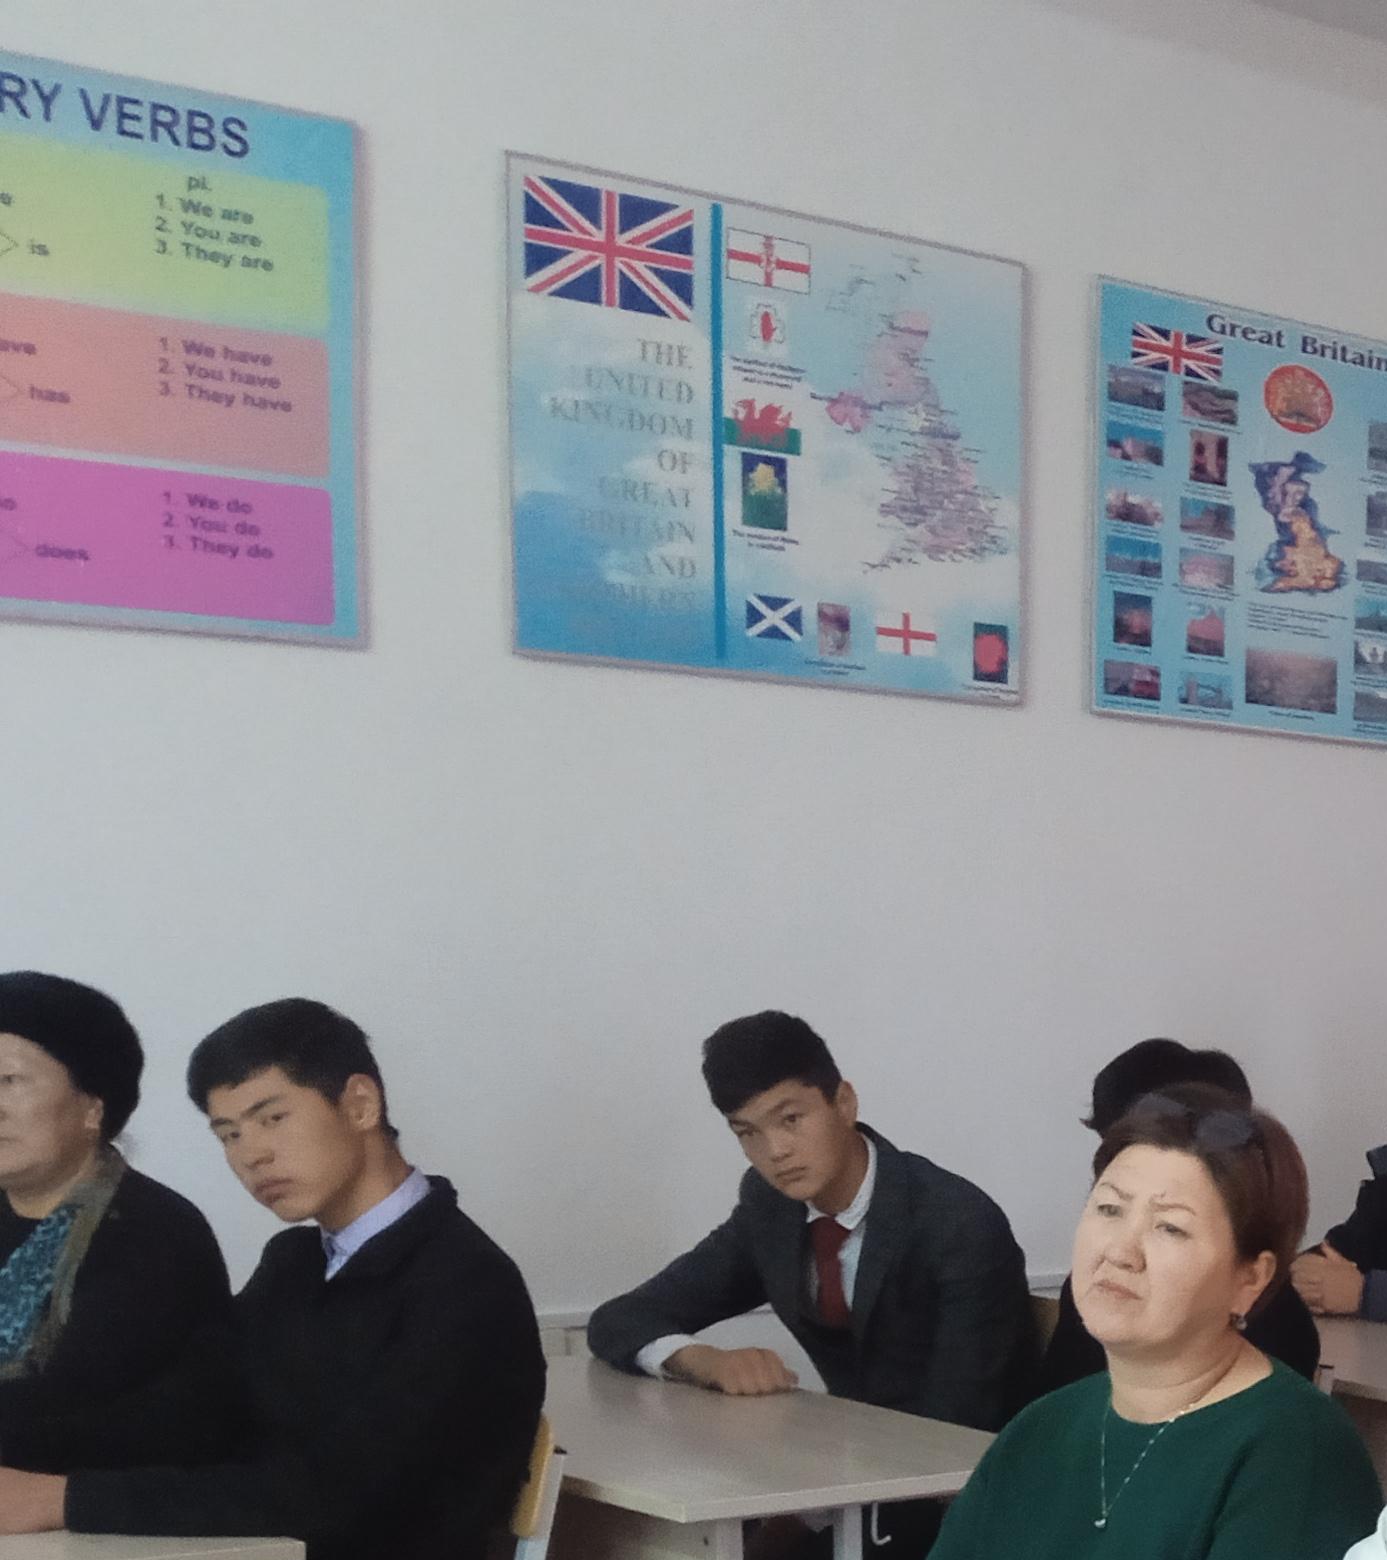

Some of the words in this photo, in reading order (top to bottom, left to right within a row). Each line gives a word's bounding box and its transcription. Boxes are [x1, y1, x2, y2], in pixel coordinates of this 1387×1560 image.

[79, 87, 249, 158] VERBS
[177, 197, 214, 218] We
[220, 208, 254, 225] are
[181, 220, 220, 240] You
[228, 231, 262, 248] are
[181, 241, 235, 268] They
[240, 254, 274, 272] are
[1206, 313, 1285, 348] Great
[182, 339, 215, 358] We
[223, 345, 273, 367] have
[185, 362, 225, 381] You
[230, 368, 281, 390] have
[185, 383, 236, 408] They
[243, 392, 292, 413] have
[226, 498, 253, 515] do
[188, 514, 228, 533] You
[234, 520, 261, 537] do
[190, 536, 240, 560] They
[246, 543, 275, 560] do
